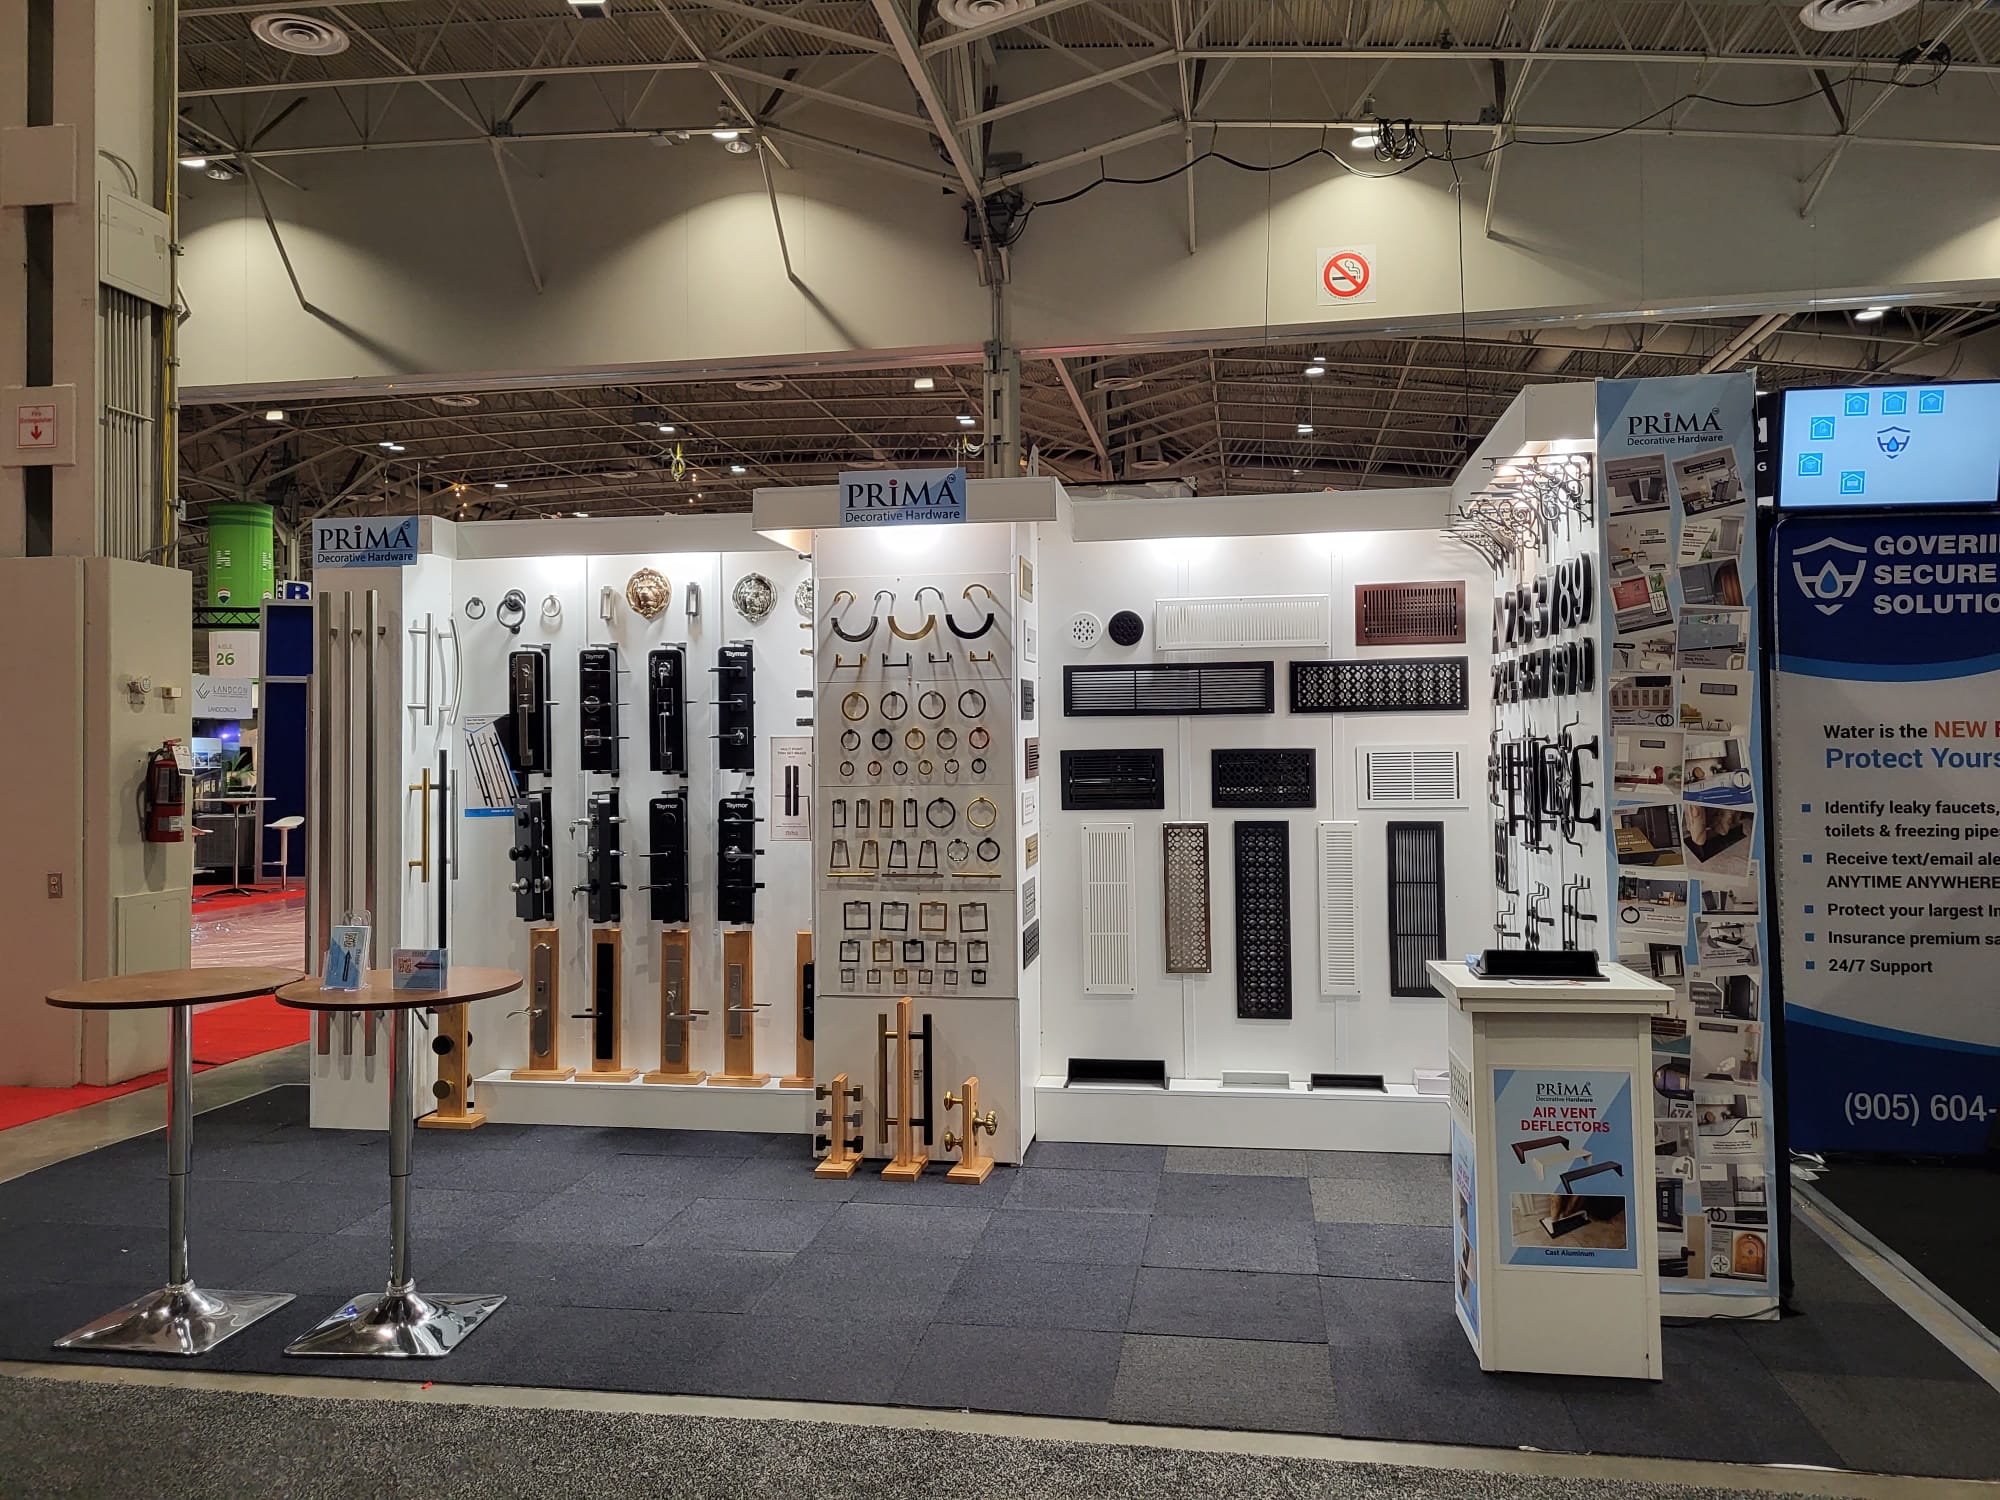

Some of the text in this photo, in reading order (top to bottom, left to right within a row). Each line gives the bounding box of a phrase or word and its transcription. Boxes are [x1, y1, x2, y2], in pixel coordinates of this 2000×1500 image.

[1627, 434, 1724, 446] Decorative Hardware
[845, 509, 960, 523] Decorative Hardware
[1874, 534, 2000, 555] GOVERII
[317, 552, 414, 563] Decorative Hardware
[1874, 564, 1997, 584] SECURE
[1873, 594, 2000, 614] SOLUTIO
[216, 652, 235, 666] 26
[724, 650, 748, 658] Taymor
[212, 685, 248, 694] LANDCON
[1824, 725, 1876, 739] Water
[1880, 724, 1895, 738] is
[1899, 724, 1928, 738] the
[1933, 721, 1988, 738] NEW
[1826, 747, 1924, 769] Protect
[1825, 800, 2000, 818] Identify leaky faucets,
[1825, 822, 2000, 841] toilets & freezing pipe
[1826, 851, 2000, 866] Receive text/email ale
[1826, 875, 2000, 890] ANYTIME ANYWHERE
[1828, 902, 1885, 918] Protect
[1888, 906, 1924, 920] your
[1928, 902, 1984, 920] largest
[1828, 931, 1906, 946] Insurance
[1910, 932, 1981, 949] premium
[1828, 958, 1933, 976] 24/7 Support
[1533, 1107, 1597, 1118] AIR VENT
[1844, 1092, 1998, 1126] (905) 604-
[1521, 1120, 1610, 1133] DEFLECTORS
[1561, 1250, 1595, 1258] Aluminum
